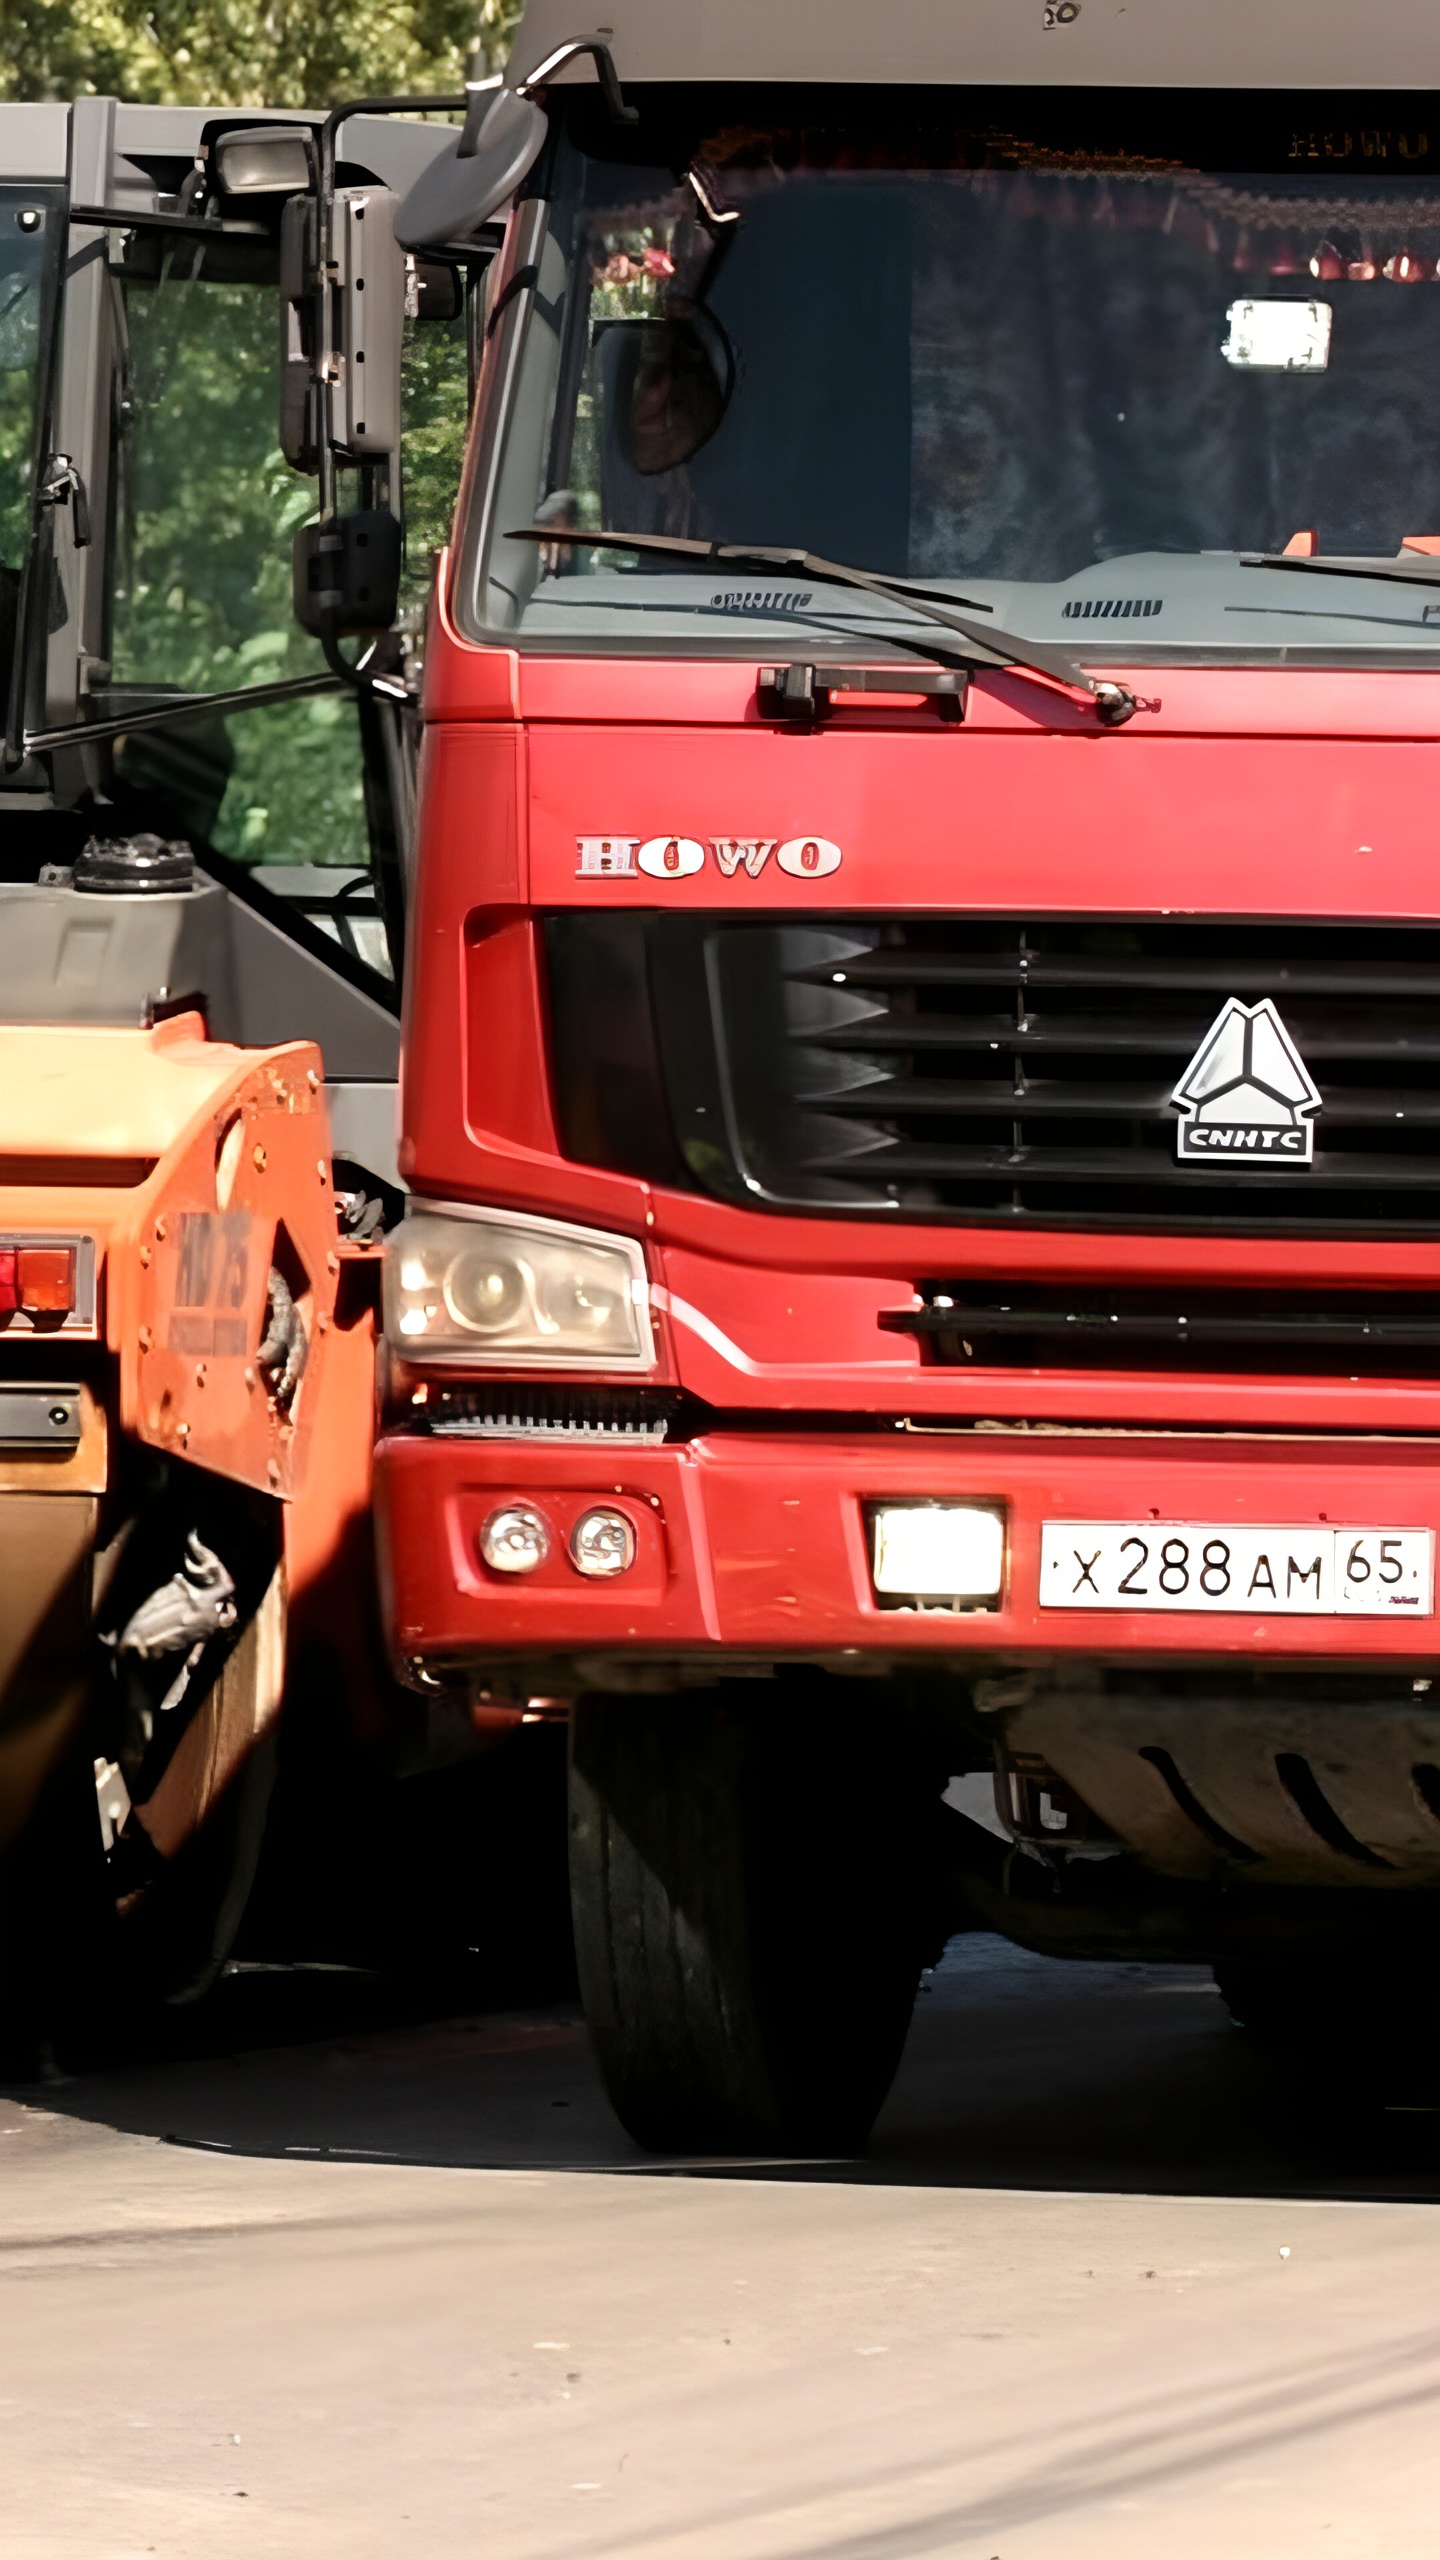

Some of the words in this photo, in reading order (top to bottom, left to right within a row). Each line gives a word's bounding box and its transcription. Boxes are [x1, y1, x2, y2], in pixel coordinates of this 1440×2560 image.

[575, 834, 842, 879] HOWO
[1189, 1128, 1302, 1149] CNHTC
[1345, 1539, 1403, 1584] 65
